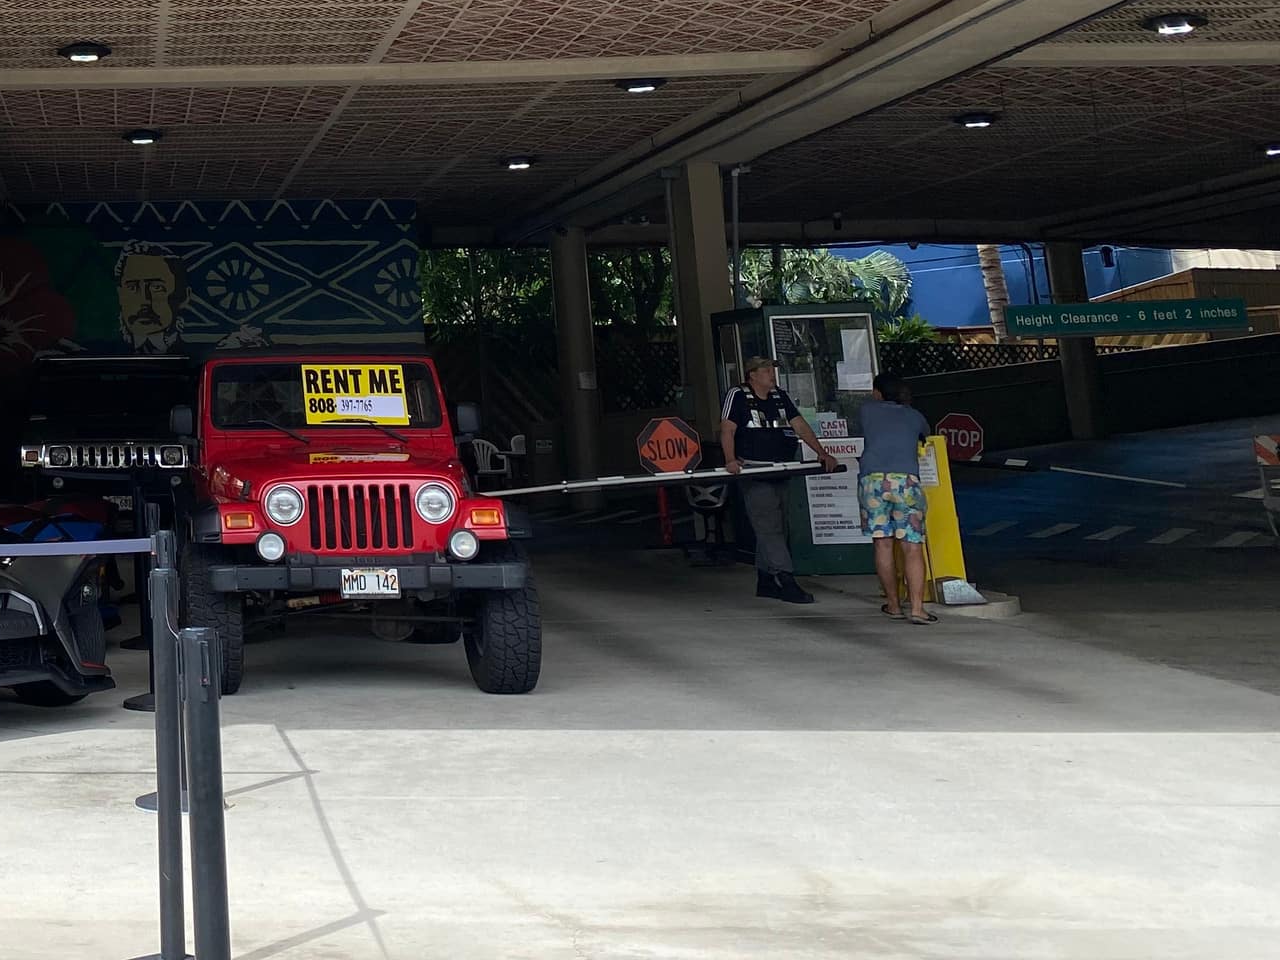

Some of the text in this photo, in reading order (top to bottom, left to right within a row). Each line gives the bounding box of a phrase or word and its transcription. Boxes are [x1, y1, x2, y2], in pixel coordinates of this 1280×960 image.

[1015, 314, 1054, 328] Height
[1060, 312, 1119, 325] Clearance
[1138, 310, 1147, 321] 6
[1153, 309, 1178, 321] feet
[1185, 308, 1193, 319] 2
[1200, 307, 1238, 319] inches
[304, 369, 402, 394] RENT ME
[820, 421, 846, 430] CASH
[647, 438, 688, 461] SLOW
[823, 445, 857, 455] ONARCH
[344, 574, 397, 591] MMD 142
